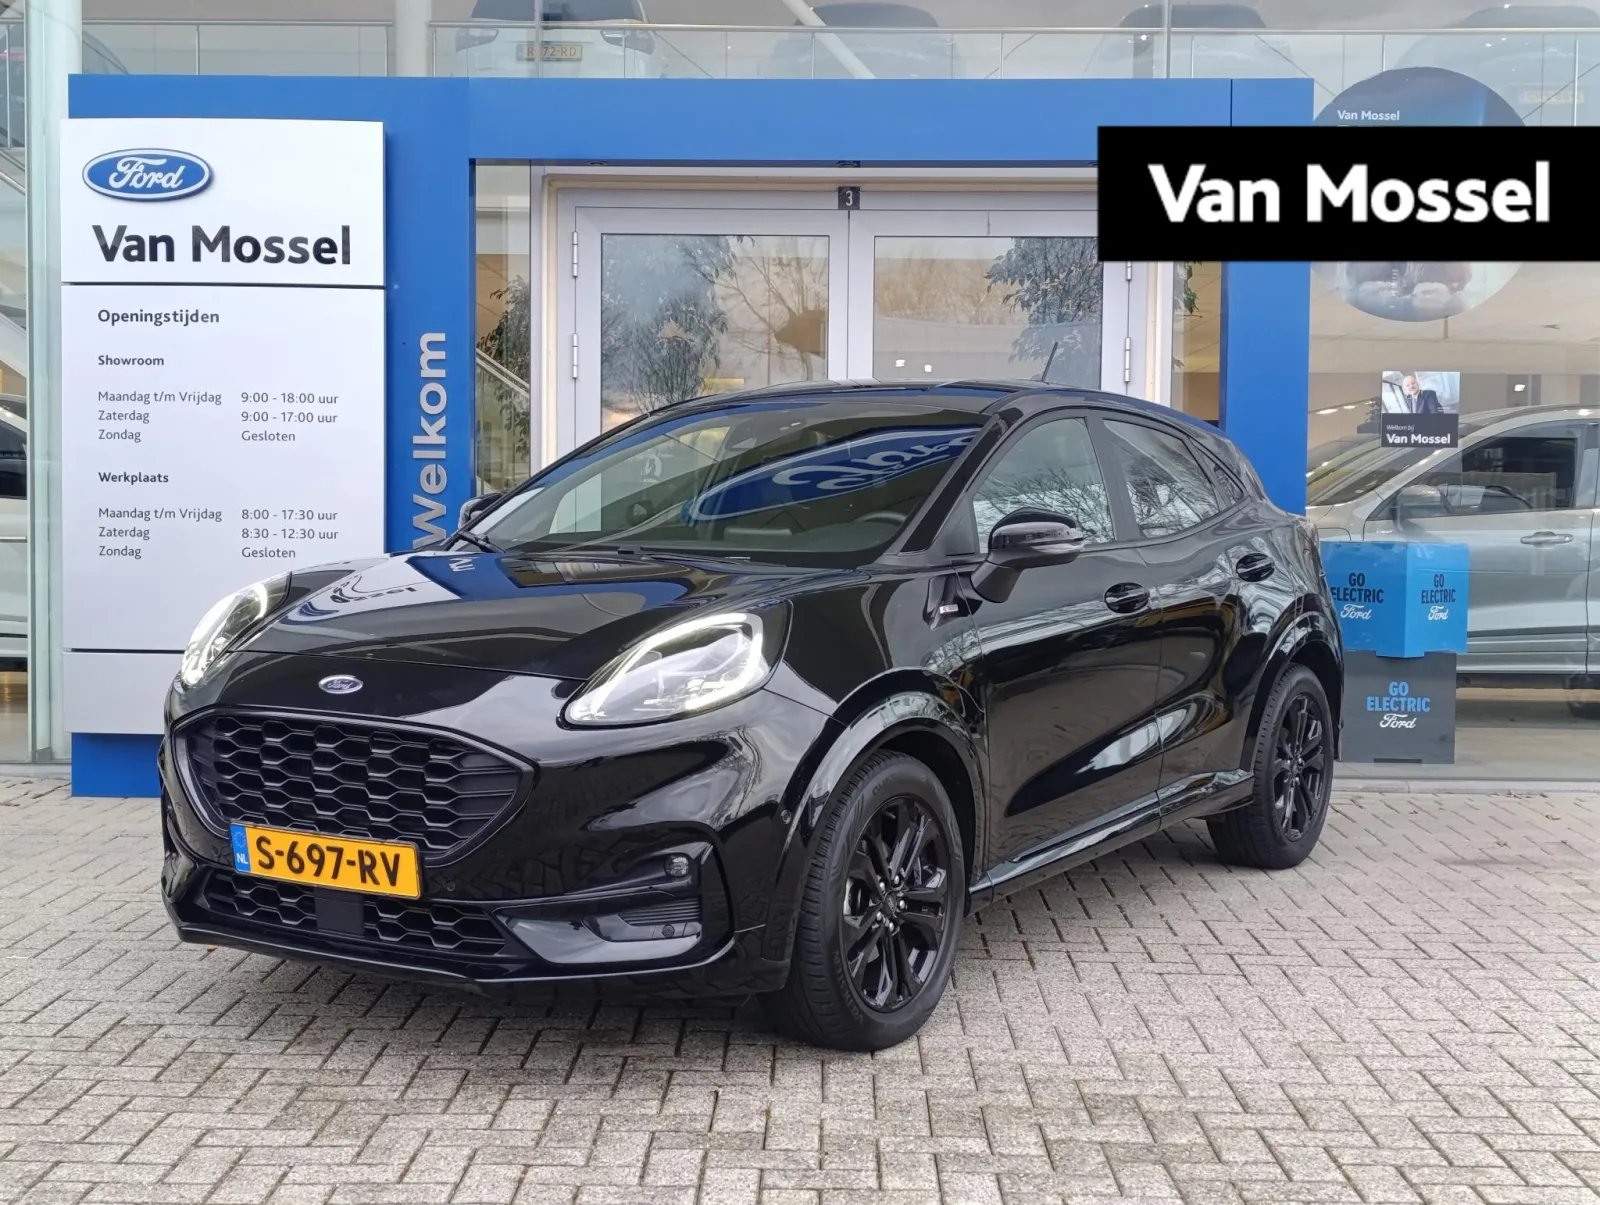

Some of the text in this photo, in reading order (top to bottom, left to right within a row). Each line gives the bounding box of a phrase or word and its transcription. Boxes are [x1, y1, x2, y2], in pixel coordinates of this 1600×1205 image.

[527, 46, 577, 57] R72-RD
[1337, 110, 1400, 121] Van Mossel
[109, 156, 186, 189] Ford
[845, 190, 853, 207] 3
[92, 225, 351, 265] Van Mossel
[97, 309, 220, 326] Openingstijden
[97, 355, 165, 366] Showroom
[98, 391, 150, 405] Maandag
[153, 391, 176, 402] t/m
[179, 391, 222, 405] Vrijdag
[241, 392, 269, 403] 9:00
[281, 392, 315, 404] 18:00
[318, 394, 339, 404] uur
[98, 410, 150, 424] Zaterdag
[241, 411, 269, 422] 9:00
[281, 412, 314, 423] 17:00
[317, 414, 338, 423] uur
[98, 429, 296, 443] Zondag Gesloten
[412, 332, 447, 550] Welkom
[1386, 433, 1451, 445] Van Mossel
[98, 472, 169, 484] Werkplaats
[98, 508, 150, 522] Maandag
[153, 508, 176, 519] t/m
[179, 508, 223, 522] Vrijdag
[241, 509, 269, 520] 8:00
[281, 509, 314, 521] 17:30
[317, 511, 338, 521] uur
[98, 527, 150, 541] Zaterdag
[241, 529, 269, 539] 8:30
[281, 529, 315, 540] 12:30
[318, 531, 339, 540] uur
[98, 546, 296, 560] Zondag Gesloten
[1348, 572, 1366, 587] GO
[1433, 573, 1445, 588] GO
[1421, 588, 1456, 604] ELECTRIC
[1340, 604, 1372, 619] Ford
[1427, 605, 1449, 621] Ford
[1388, 681, 1409, 697] GO
[1366, 697, 1430, 713] ELECTRIC
[1379, 713, 1417, 729] Ford
[237, 836, 400, 887] NL S-697-RV
